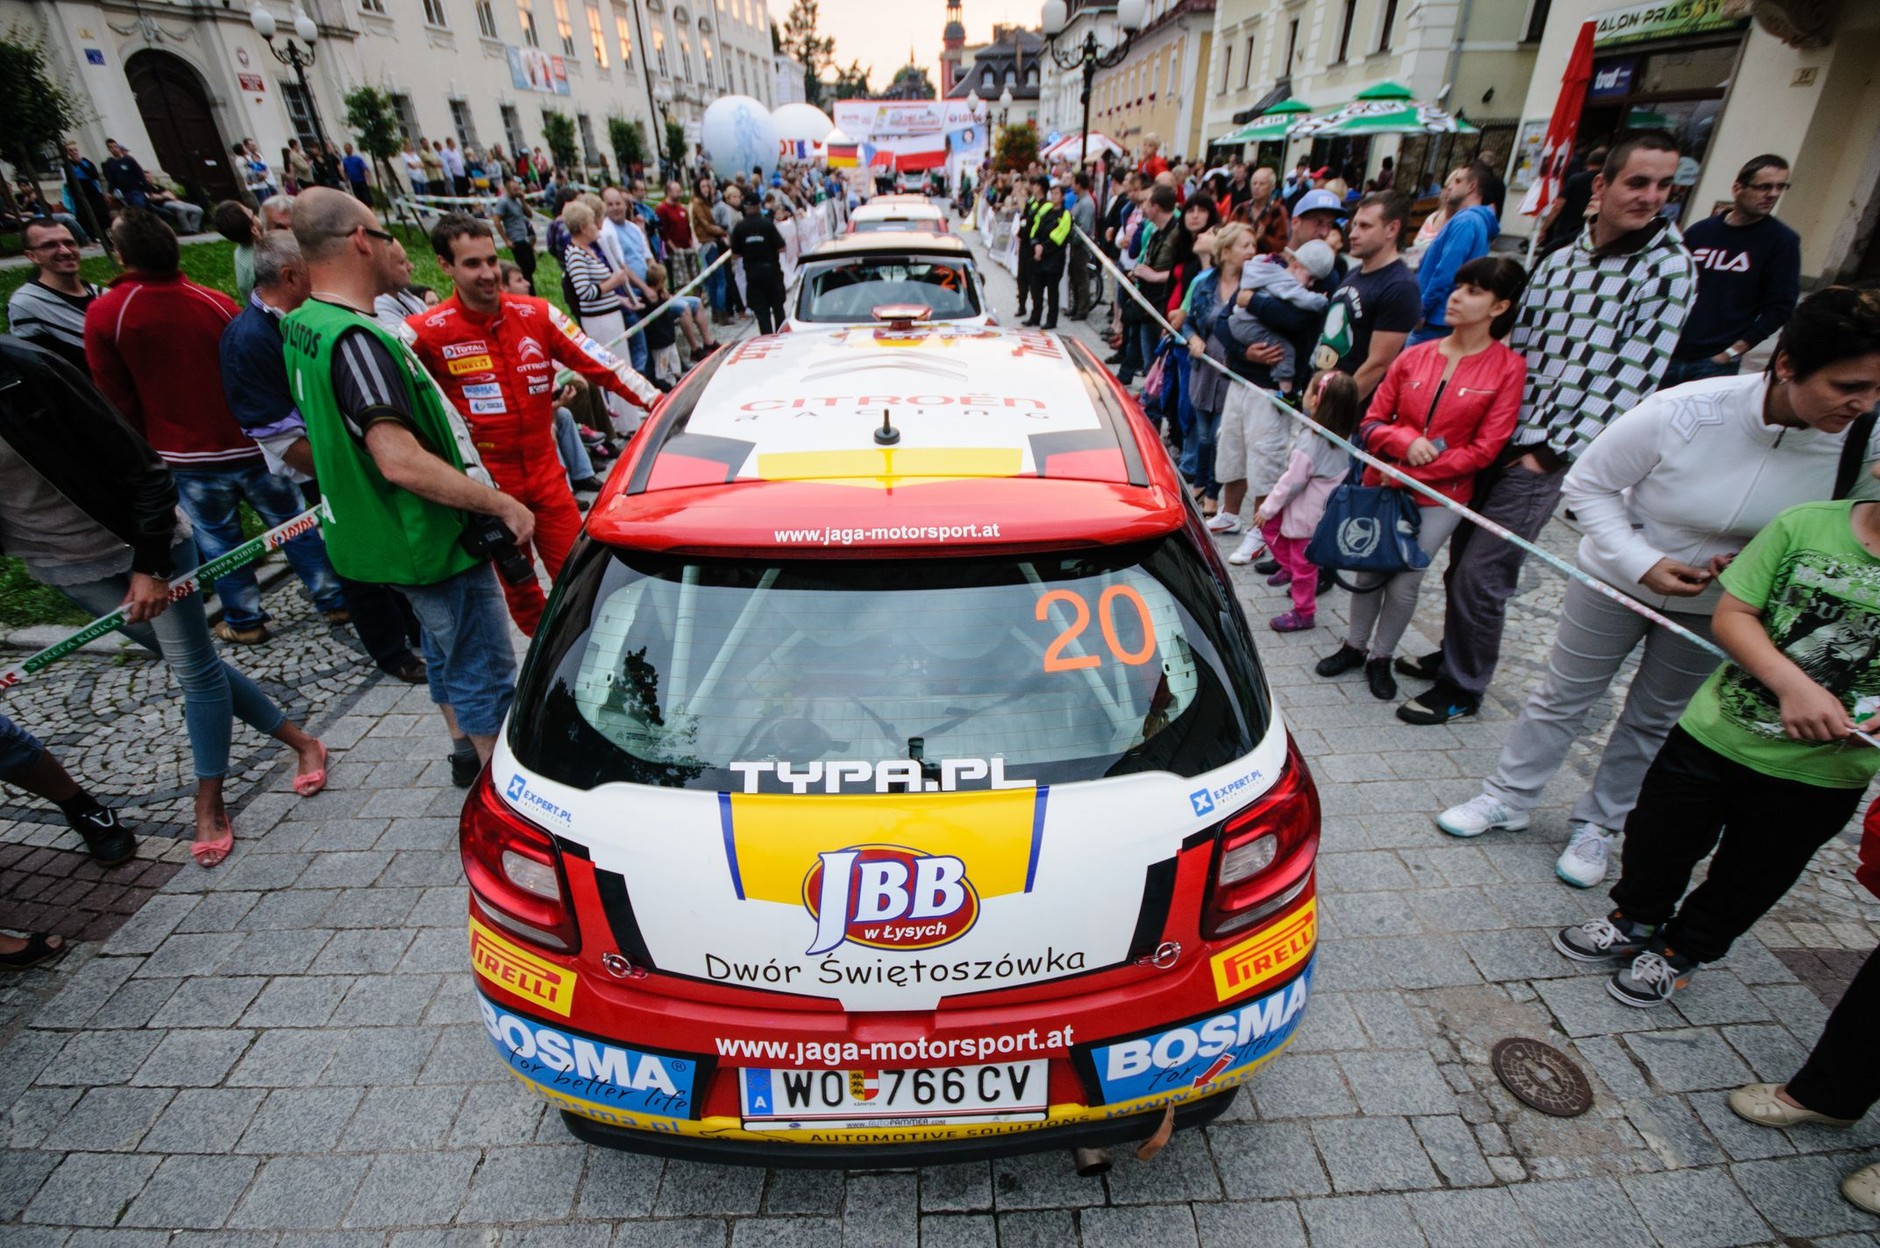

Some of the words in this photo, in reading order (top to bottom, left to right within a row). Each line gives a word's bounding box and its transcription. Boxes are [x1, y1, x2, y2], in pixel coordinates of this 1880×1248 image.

[1692, 248, 1751, 272] FILA
[740, 393, 1047, 411] CITROËN
[774, 522, 1001, 546] www.jaga-motorsport.at
[27, 641, 76, 670] STREFA
[77, 618, 121, 642] KIBICA
[1034, 585, 1157, 673] 20
[729, 757, 1037, 794] TYPA.PL
[1213, 769, 1263, 800] EXPERT.PL
[523, 789, 572, 823] EXPERT.PL
[805, 850, 965, 955] JBB
[882, 922, 947, 941] Łysych
[1222, 909, 1316, 989] PIRELLI
[471, 928, 562, 1004] PIRELLI
[705, 953, 802, 984] Dwór
[818, 946, 1086, 987] Świętoszówka
[715, 1025, 1075, 1067] www.jaga-motorsport.at
[1106, 974, 1307, 1081] BOSMA
[480, 1003, 680, 1098] BOSMA
[506, 1046, 544, 1073] for
[552, 1063, 637, 1101] better
[643, 1087, 689, 1113] life
[782, 1070, 845, 1109] WO
[1147, 1060, 1200, 1092] for
[754, 1096, 767, 1109] A
[810, 1129, 958, 1144] AUTOMOTIVE
[966, 1113, 1091, 1138] SOLUTIONS
